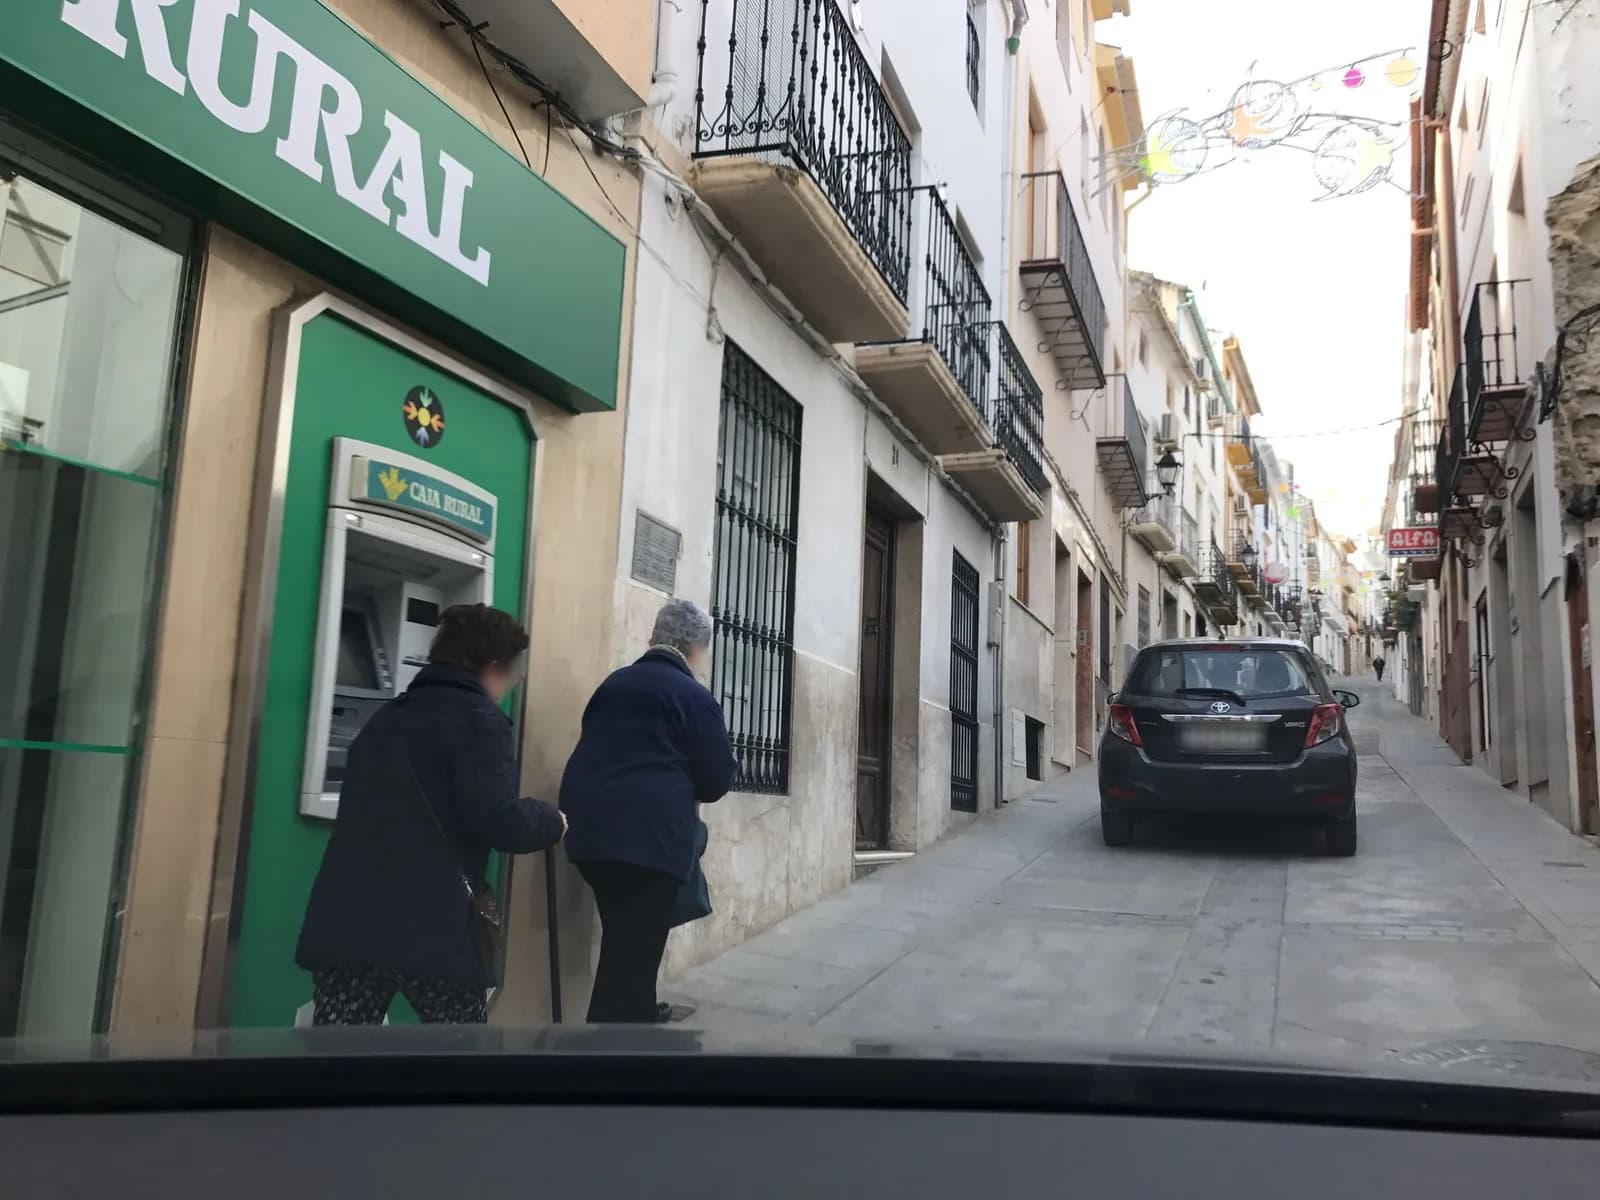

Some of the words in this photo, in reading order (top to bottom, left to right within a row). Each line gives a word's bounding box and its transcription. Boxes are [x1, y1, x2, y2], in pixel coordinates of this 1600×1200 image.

[409, 482, 441, 509] CAJA
[443, 494, 484, 525] RURAL
[1391, 531, 1435, 547] ALFA
